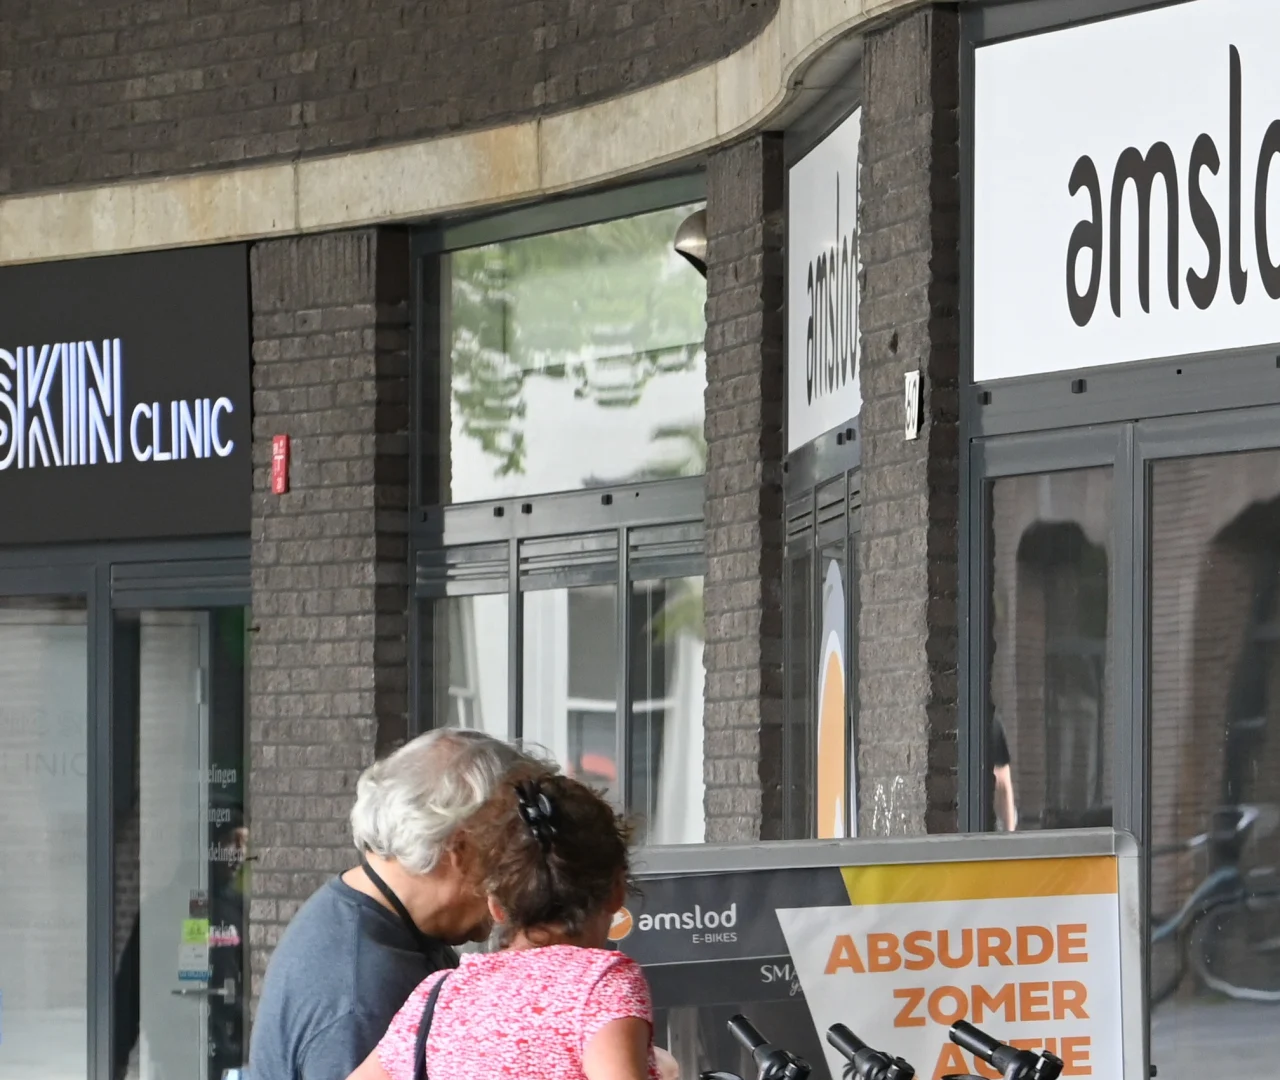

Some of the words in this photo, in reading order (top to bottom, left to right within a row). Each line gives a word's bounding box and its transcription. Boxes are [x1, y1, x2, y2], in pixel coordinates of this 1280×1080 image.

[130, 396, 234, 462] CLINIC
[906, 379, 918, 432] 60
[638, 902, 737, 932] amslod
[692, 931, 738, 944] E-BIKES
[823, 923, 1089, 975] ABSURDE
[893, 980, 1091, 1028] ZOMER
